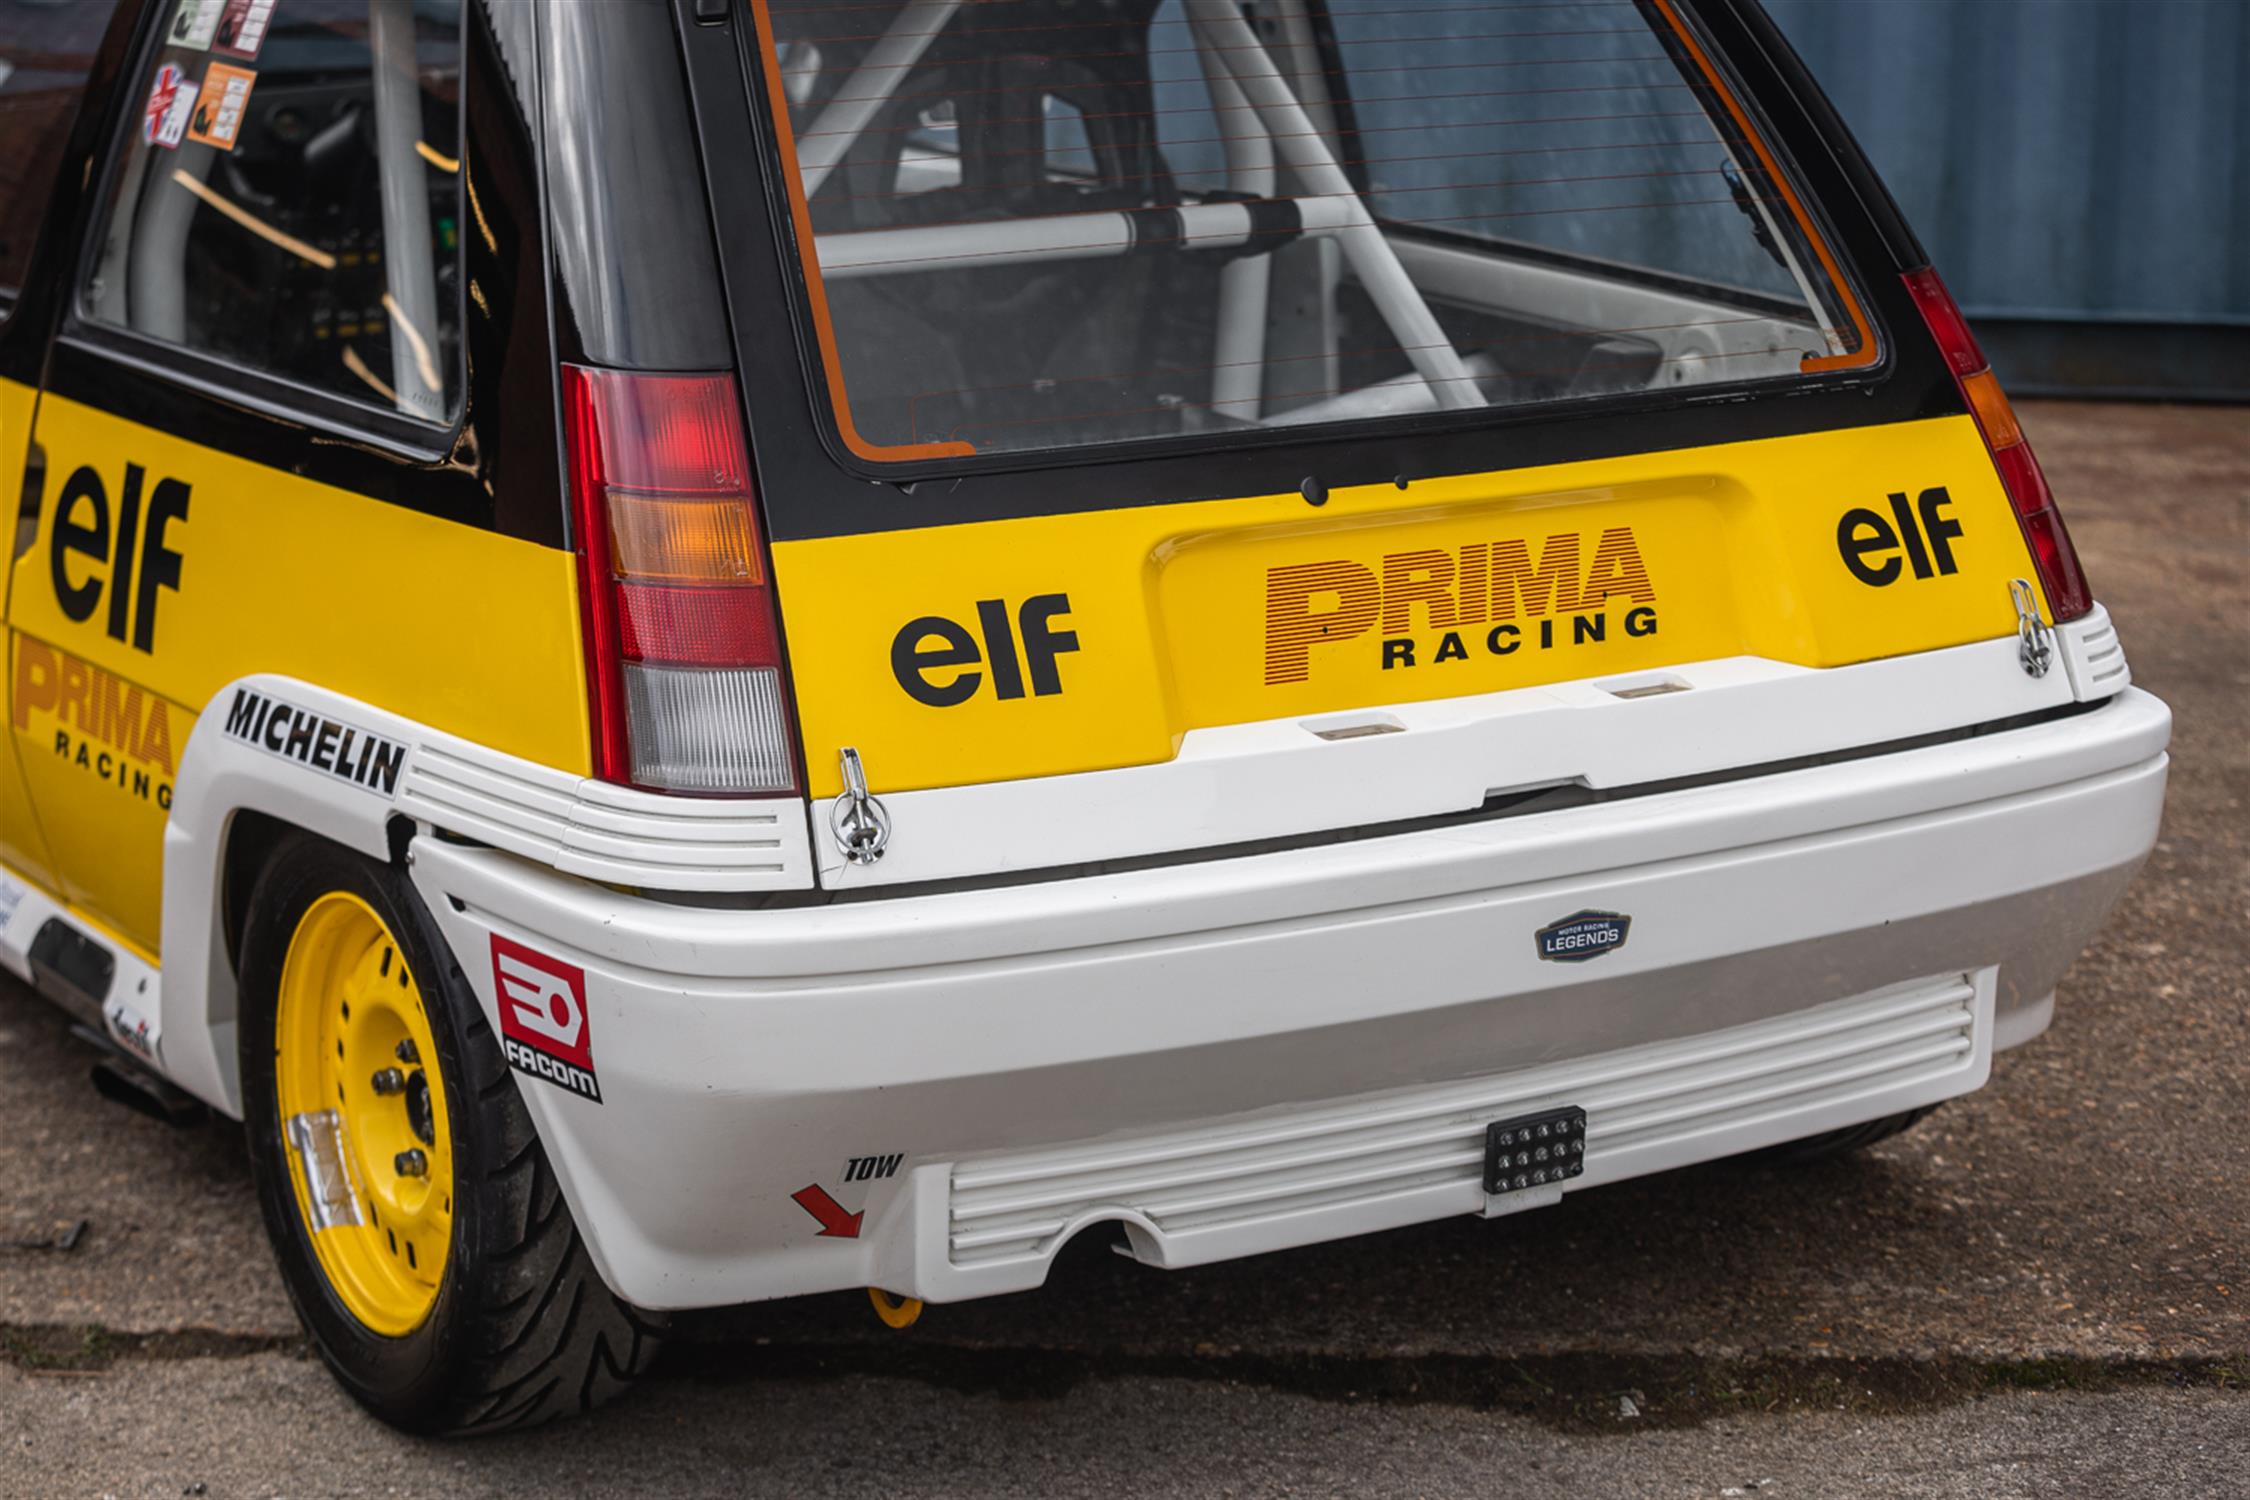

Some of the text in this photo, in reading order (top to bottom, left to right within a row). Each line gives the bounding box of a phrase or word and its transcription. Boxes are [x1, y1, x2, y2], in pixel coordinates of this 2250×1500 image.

[51, 461, 192, 656] elf
[1837, 487, 1964, 587] elf
[890, 593, 1080, 707] elf
[1264, 527, 1657, 686] PRIMA
[1382, 606, 1658, 671] RACING
[14, 632, 174, 778] PRIMA
[225, 688, 406, 795] MICHELIN
[55, 729, 172, 811] RACING
[1546, 929, 1619, 952] LEGENDS
[1558, 922, 1610, 936] MOTOR RACING
[505, 1039, 599, 1097] FACOM
[844, 1153, 904, 1182] TOW
